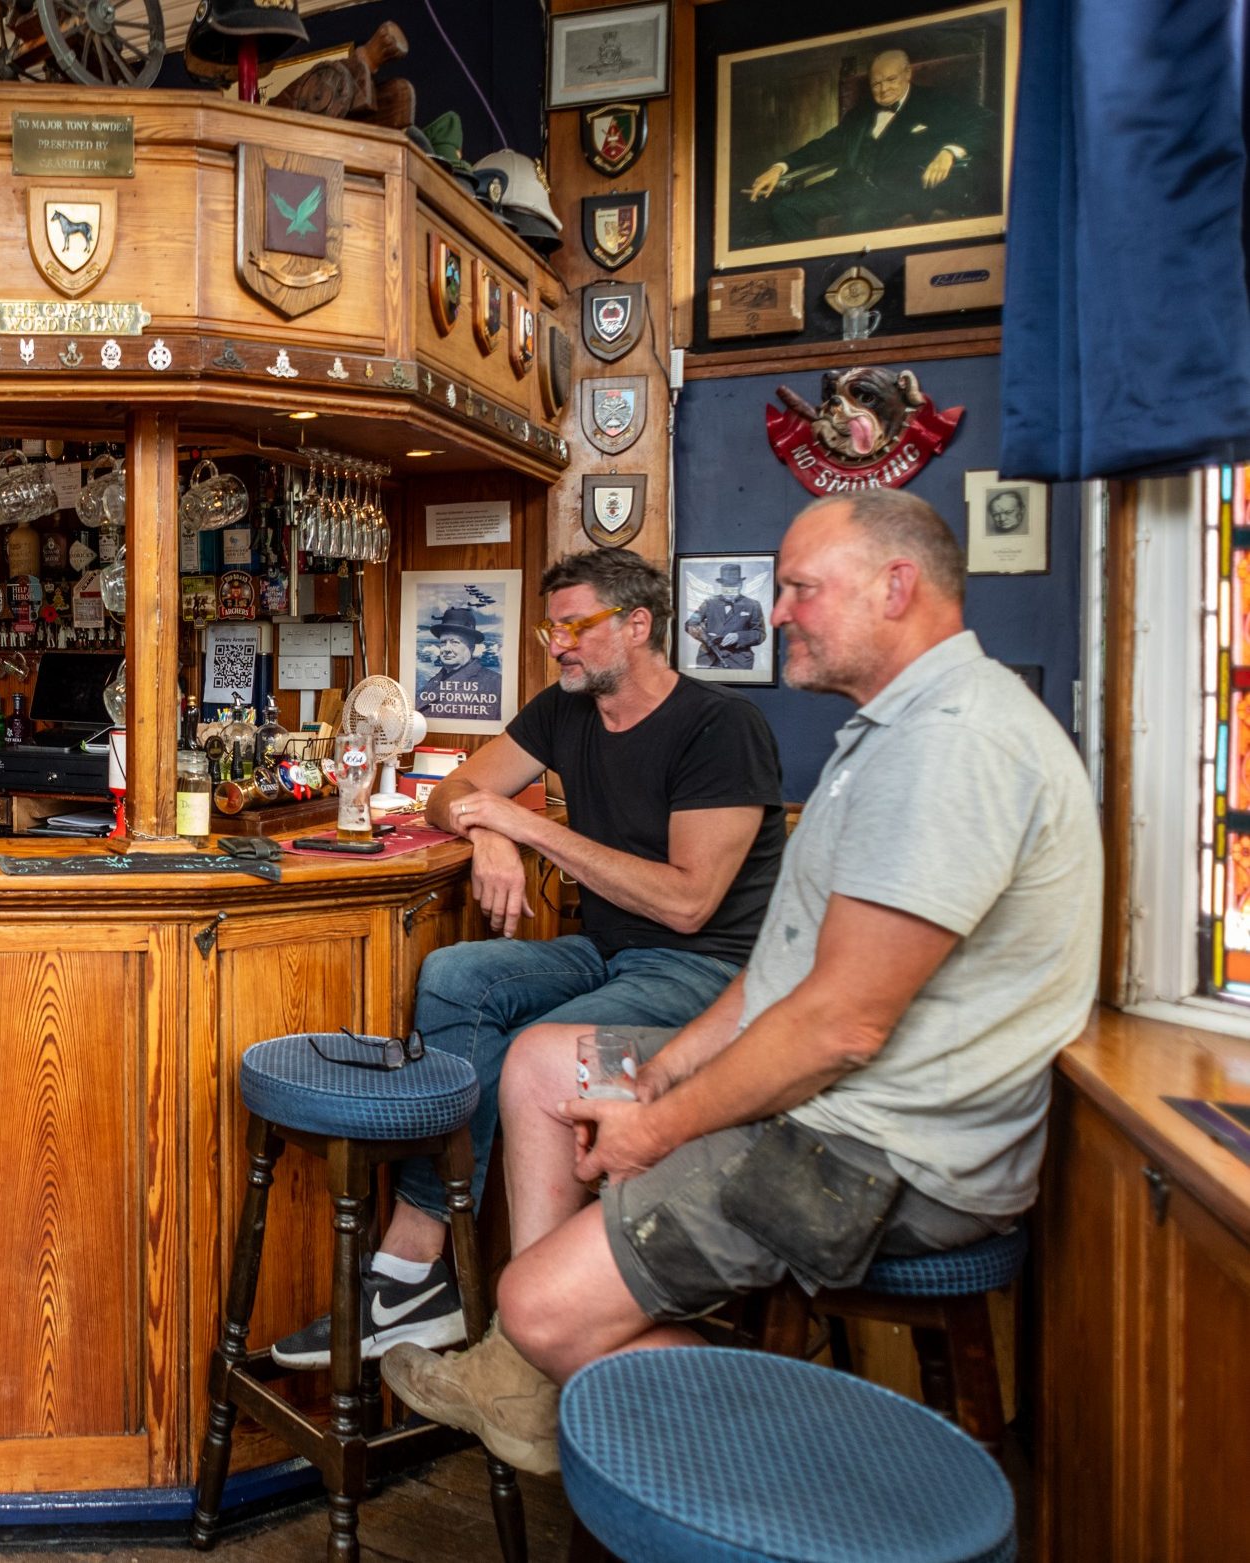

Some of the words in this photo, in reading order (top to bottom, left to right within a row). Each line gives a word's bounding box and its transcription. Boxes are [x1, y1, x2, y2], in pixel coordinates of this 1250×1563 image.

[17, 119, 29, 129] TO
[31, 120, 62, 130] MAJOR
[65, 121, 89, 131] TONY
[38, 139, 93, 150] PRESENTED
[95, 141, 109, 151] BY
[1, 303, 39, 318] THE
[3, 317, 58, 332] WORD
[64, 317, 84, 332] IS
[89, 318, 132, 333] LAW
[791, 443, 816, 470] NO
[814, 443, 920, 492] SMOKING
[224, 608, 249, 617] ARCHERS
[463, 681, 479, 692] US
[419, 692, 437, 701] GO
[439, 692, 497, 704] FORWARD
